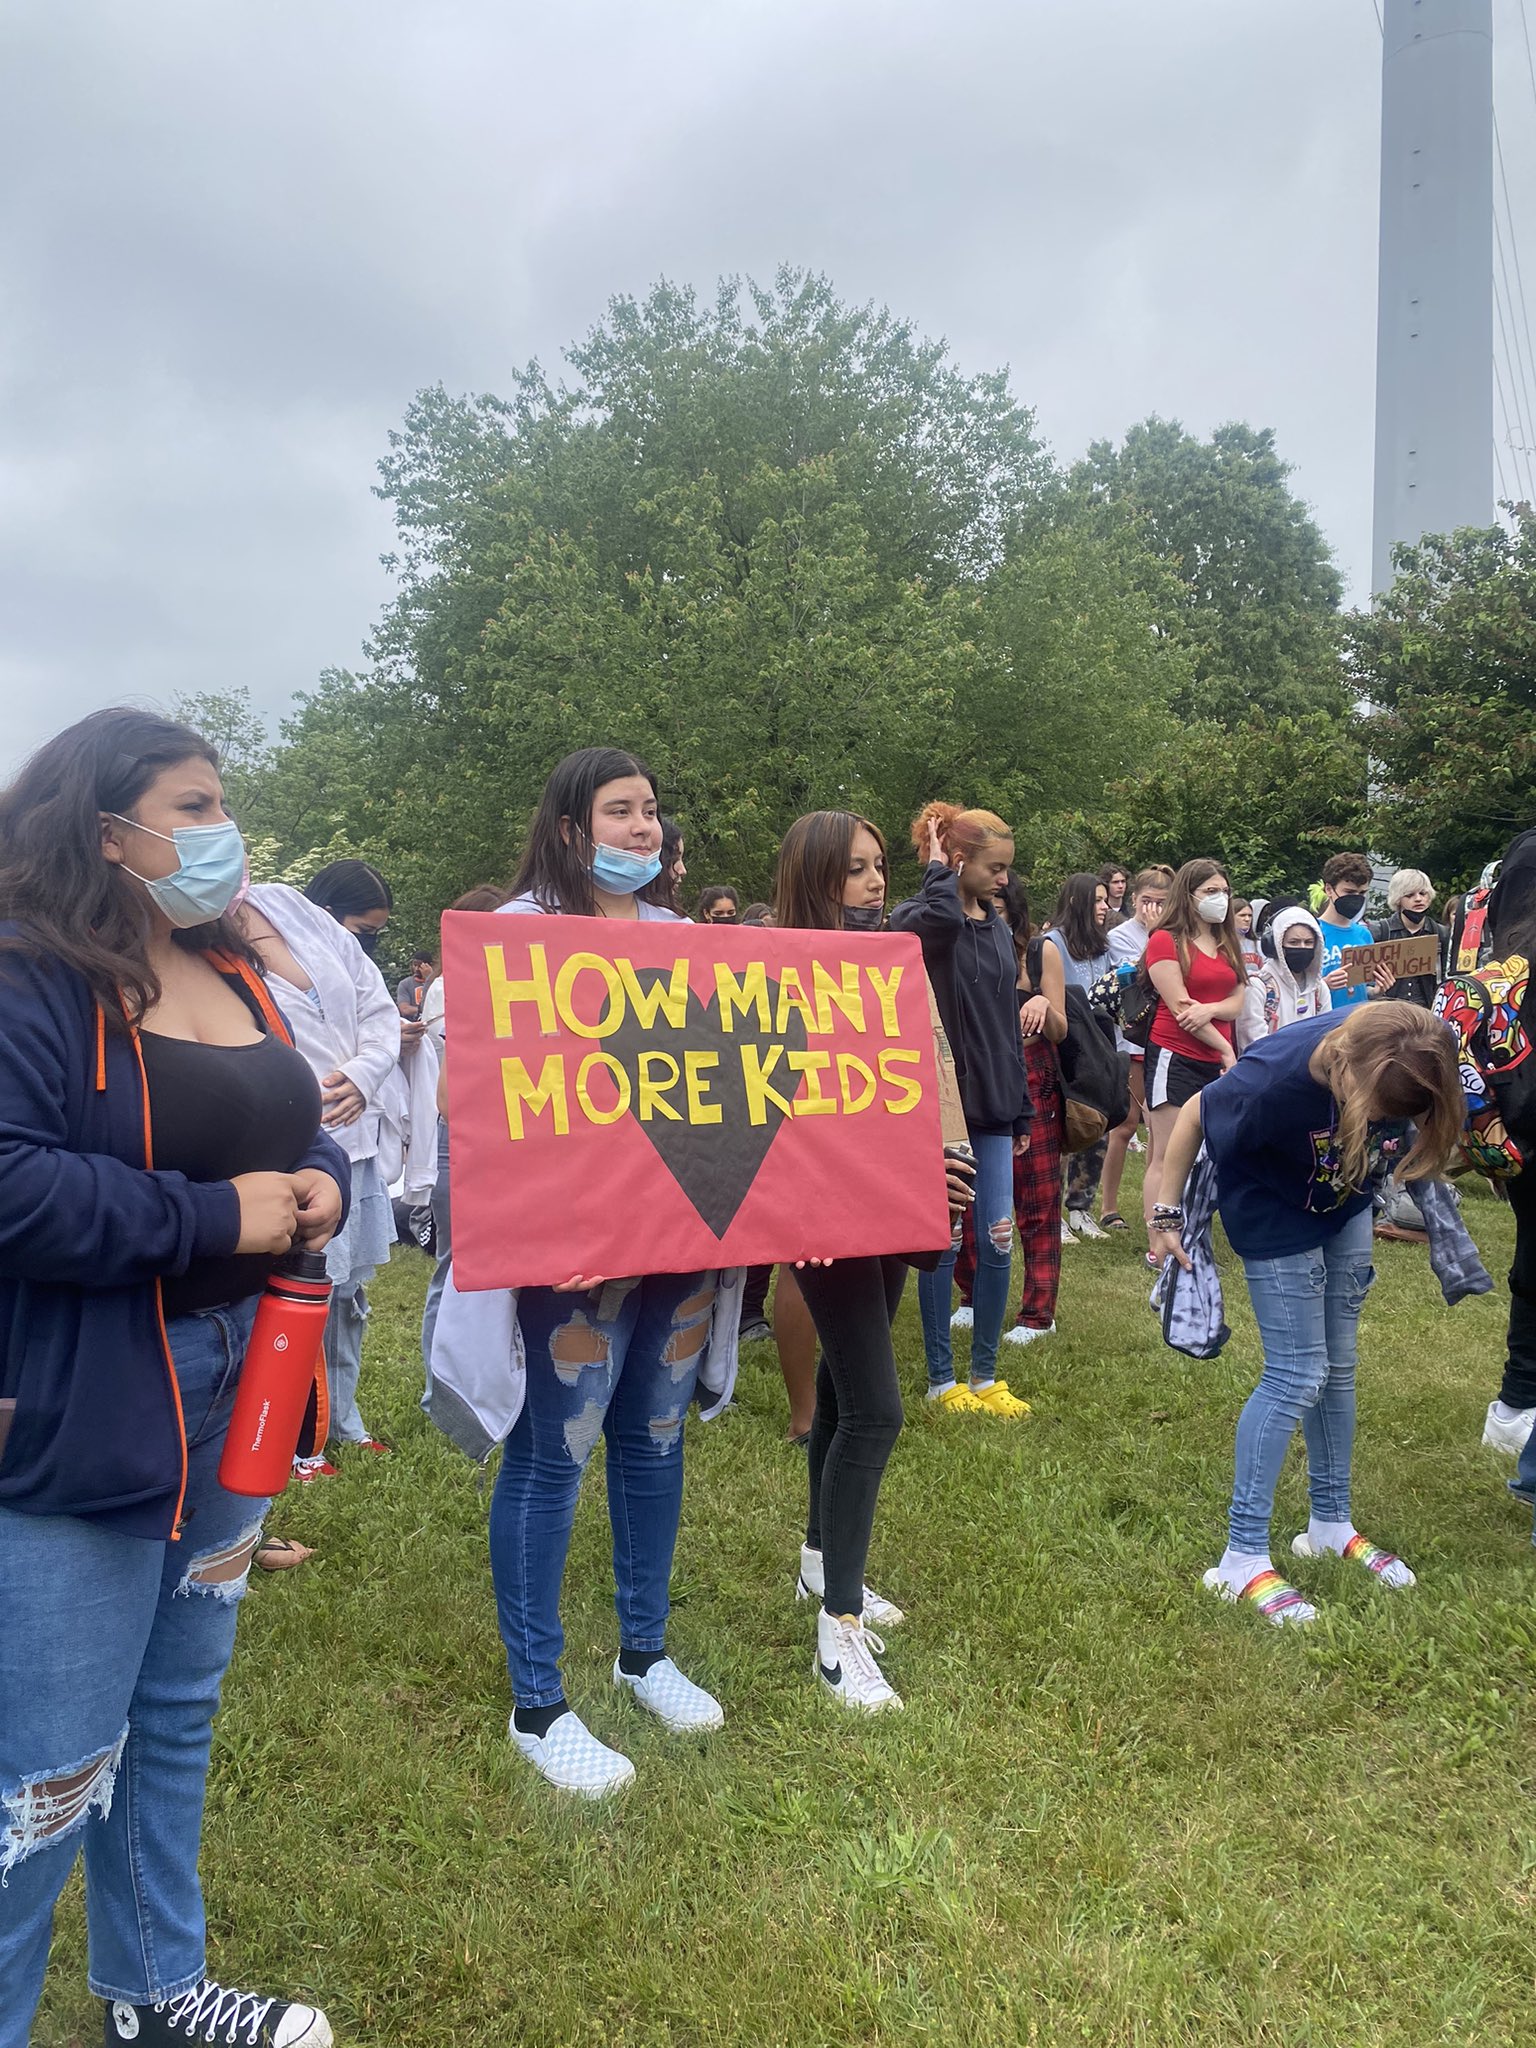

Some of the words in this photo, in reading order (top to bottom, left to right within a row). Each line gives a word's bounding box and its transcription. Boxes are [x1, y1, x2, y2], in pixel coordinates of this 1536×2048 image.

[1343, 943, 1402, 967] ENOUGH
[1363, 956, 1432, 983] EOUGH
[485, 944, 689, 1039] HOW
[713, 960, 905, 1038] MANY
[501, 1050, 722, 1140] MORE
[740, 1044, 922, 1126] KIDS
[251, 1398, 271, 1451] ThermoFlask
